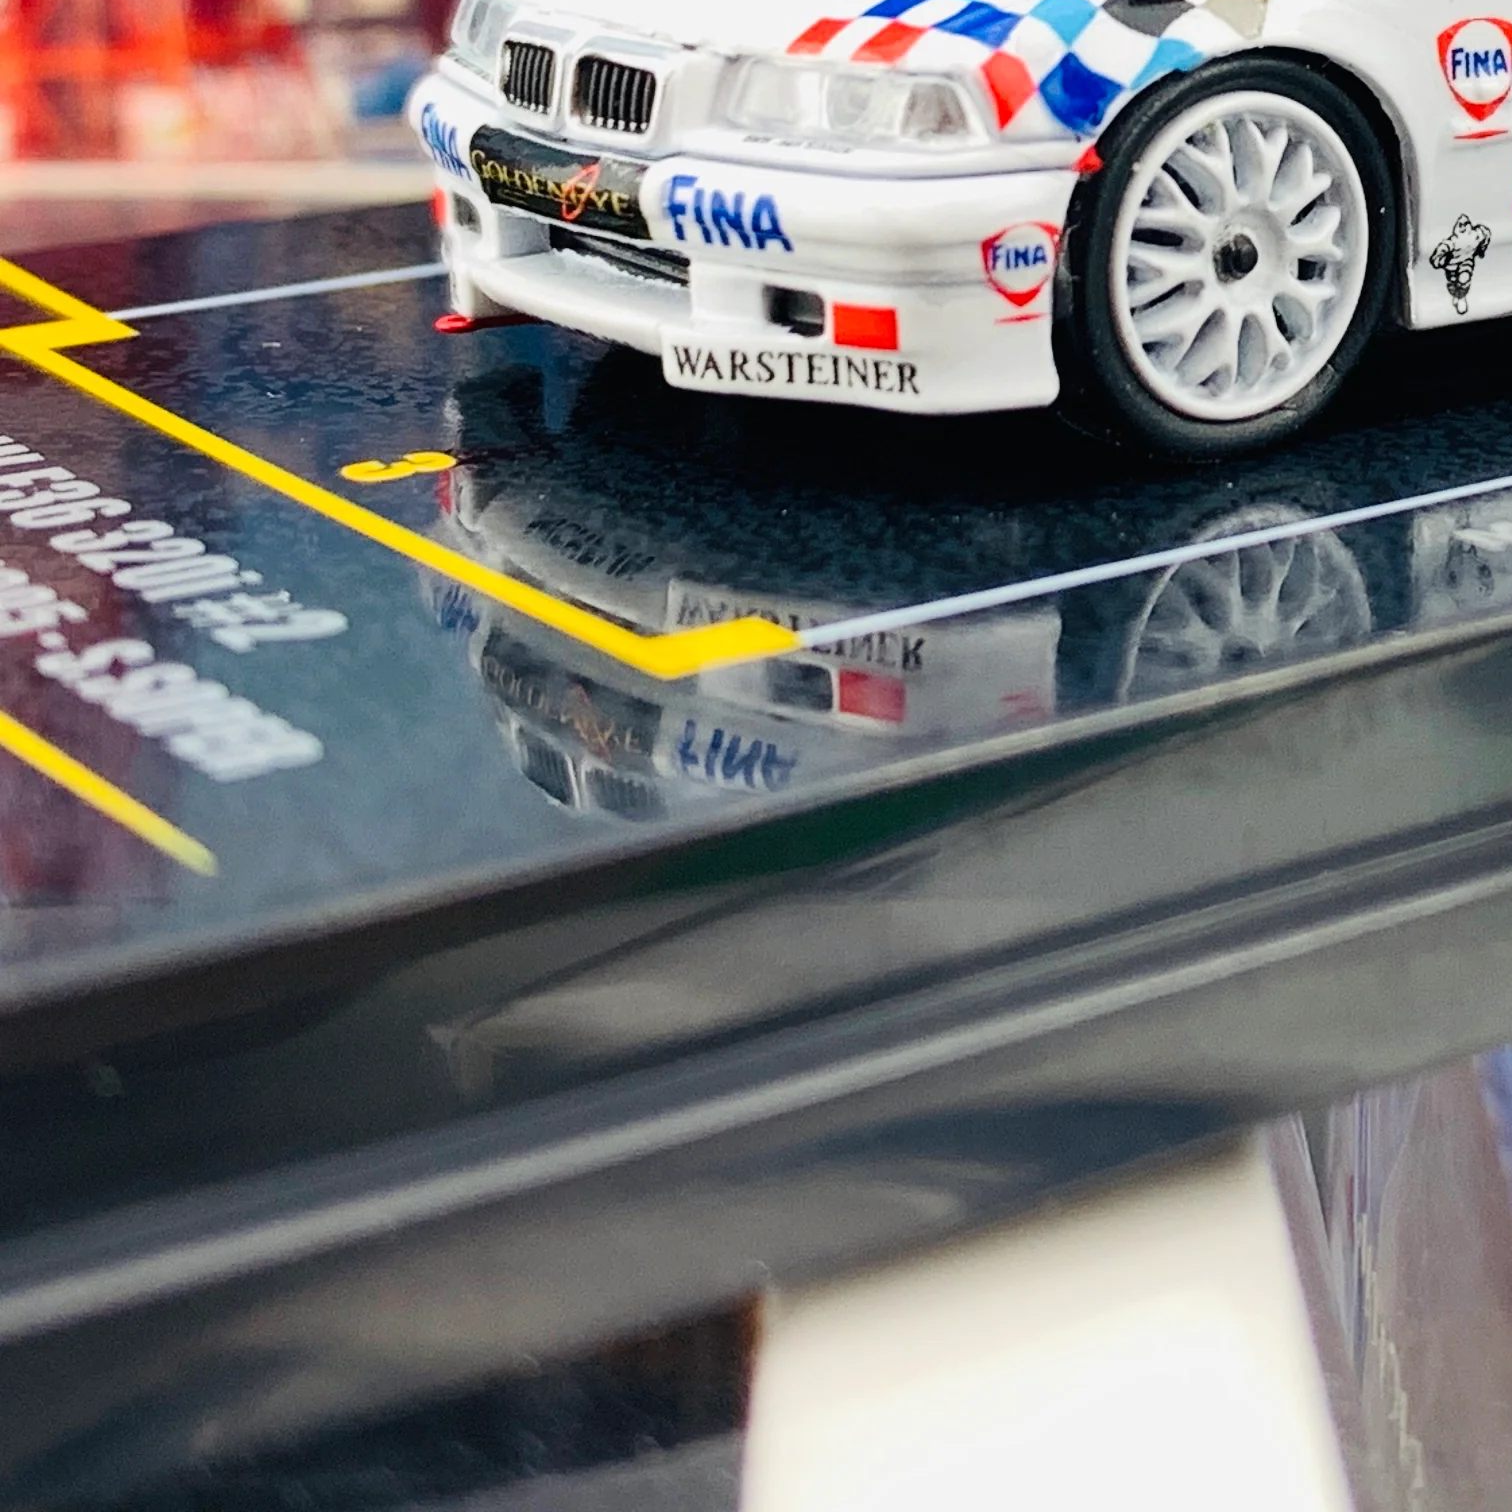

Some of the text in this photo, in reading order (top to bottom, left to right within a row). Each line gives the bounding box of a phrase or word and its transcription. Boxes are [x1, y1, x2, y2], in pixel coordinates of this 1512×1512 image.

[1451, 47, 1509, 81] FINA
[667, 174, 795, 252] FINA
[991, 243, 1047, 271] FINA
[672, 345, 921, 395] WARSTEINER
